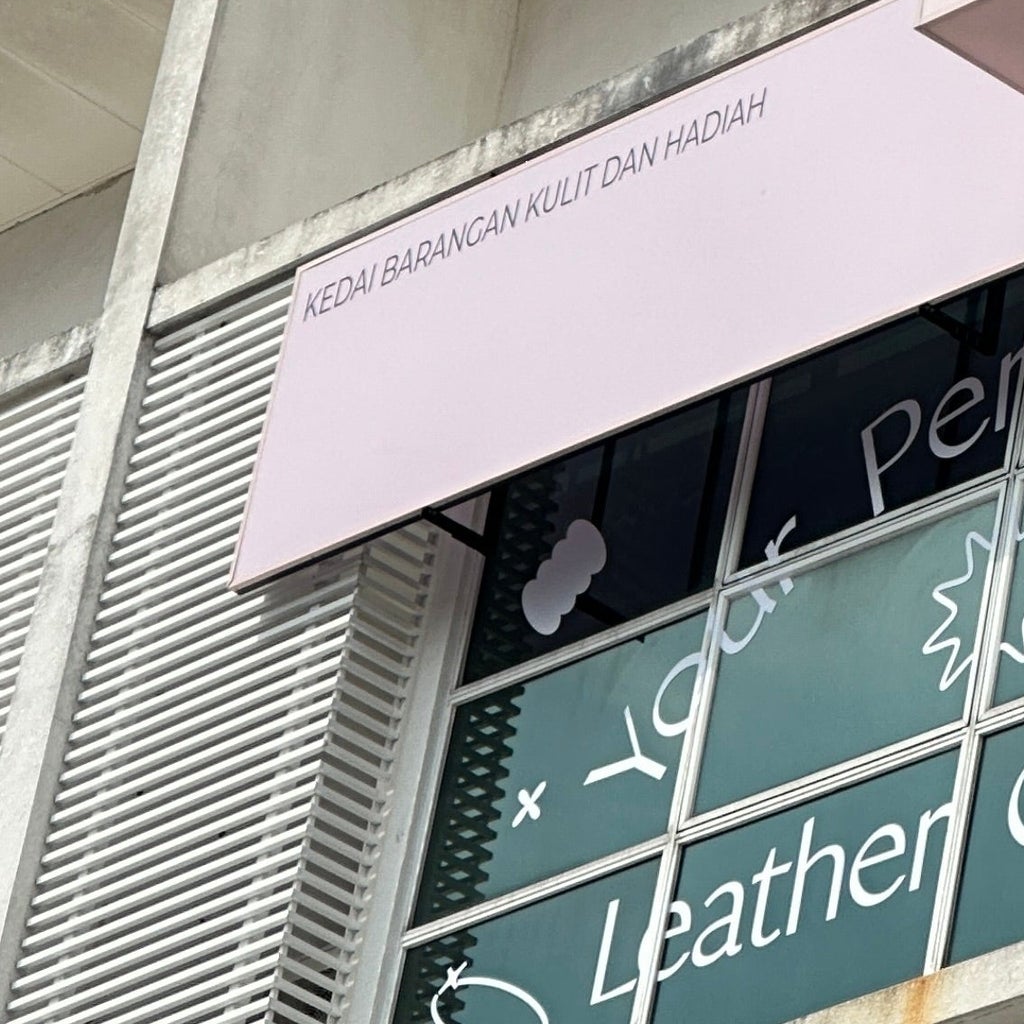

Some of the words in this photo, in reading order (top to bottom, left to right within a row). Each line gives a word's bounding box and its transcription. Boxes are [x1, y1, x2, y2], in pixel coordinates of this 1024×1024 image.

[303, 264, 378, 322] KEDAI
[380, 199, 520, 286] BARANGAN
[525, 163, 599, 222] KULIT
[601, 136, 659, 188] DAN
[664, 87, 767, 160] HADIAH
[590, 801, 953, 1006] Leather
